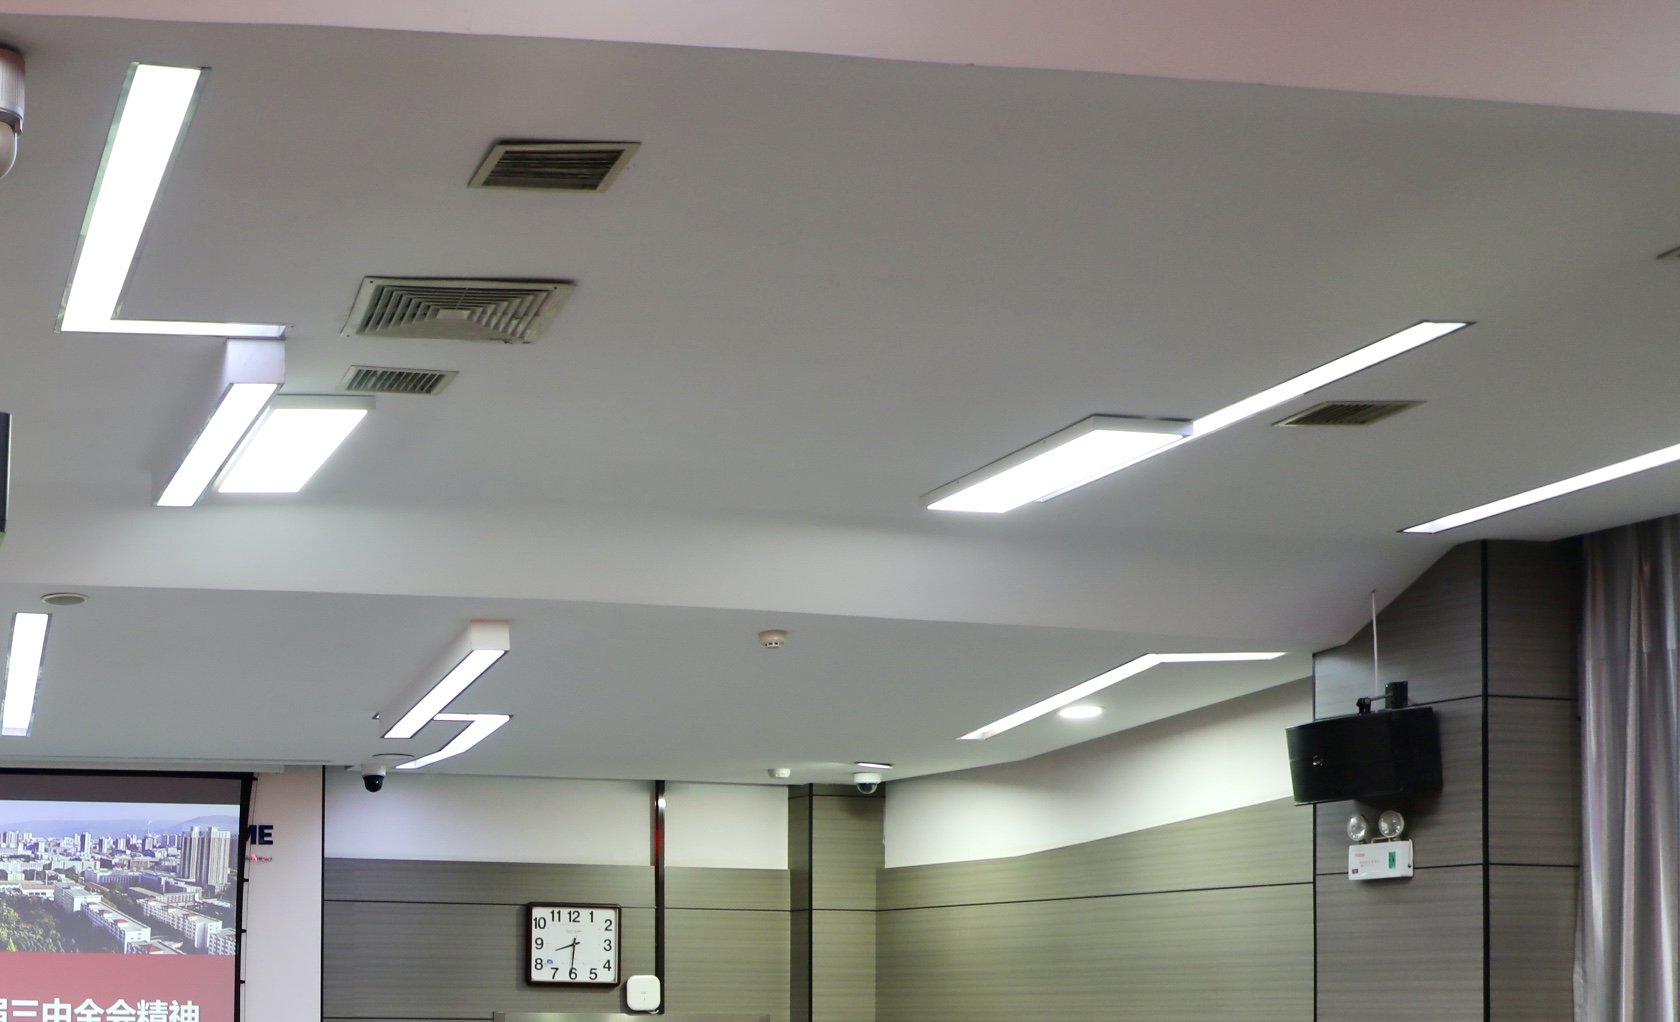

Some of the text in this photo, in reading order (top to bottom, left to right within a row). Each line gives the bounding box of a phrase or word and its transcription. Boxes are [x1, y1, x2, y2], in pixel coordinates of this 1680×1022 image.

[550, 910, 561, 922] 11
[568, 911, 580, 923] 12
[589, 911, 594, 922] 1
[533, 917, 546, 929] 10
[604, 919, 612, 931] 2
[535, 938, 543, 949] 9
[604, 939, 612, 951] 3
[535, 958, 543, 970] 8
[603, 960, 611, 971] 4
[551, 968, 558, 979] 7
[569, 968, 577, 980] 6
[589, 968, 597, 980] 5
